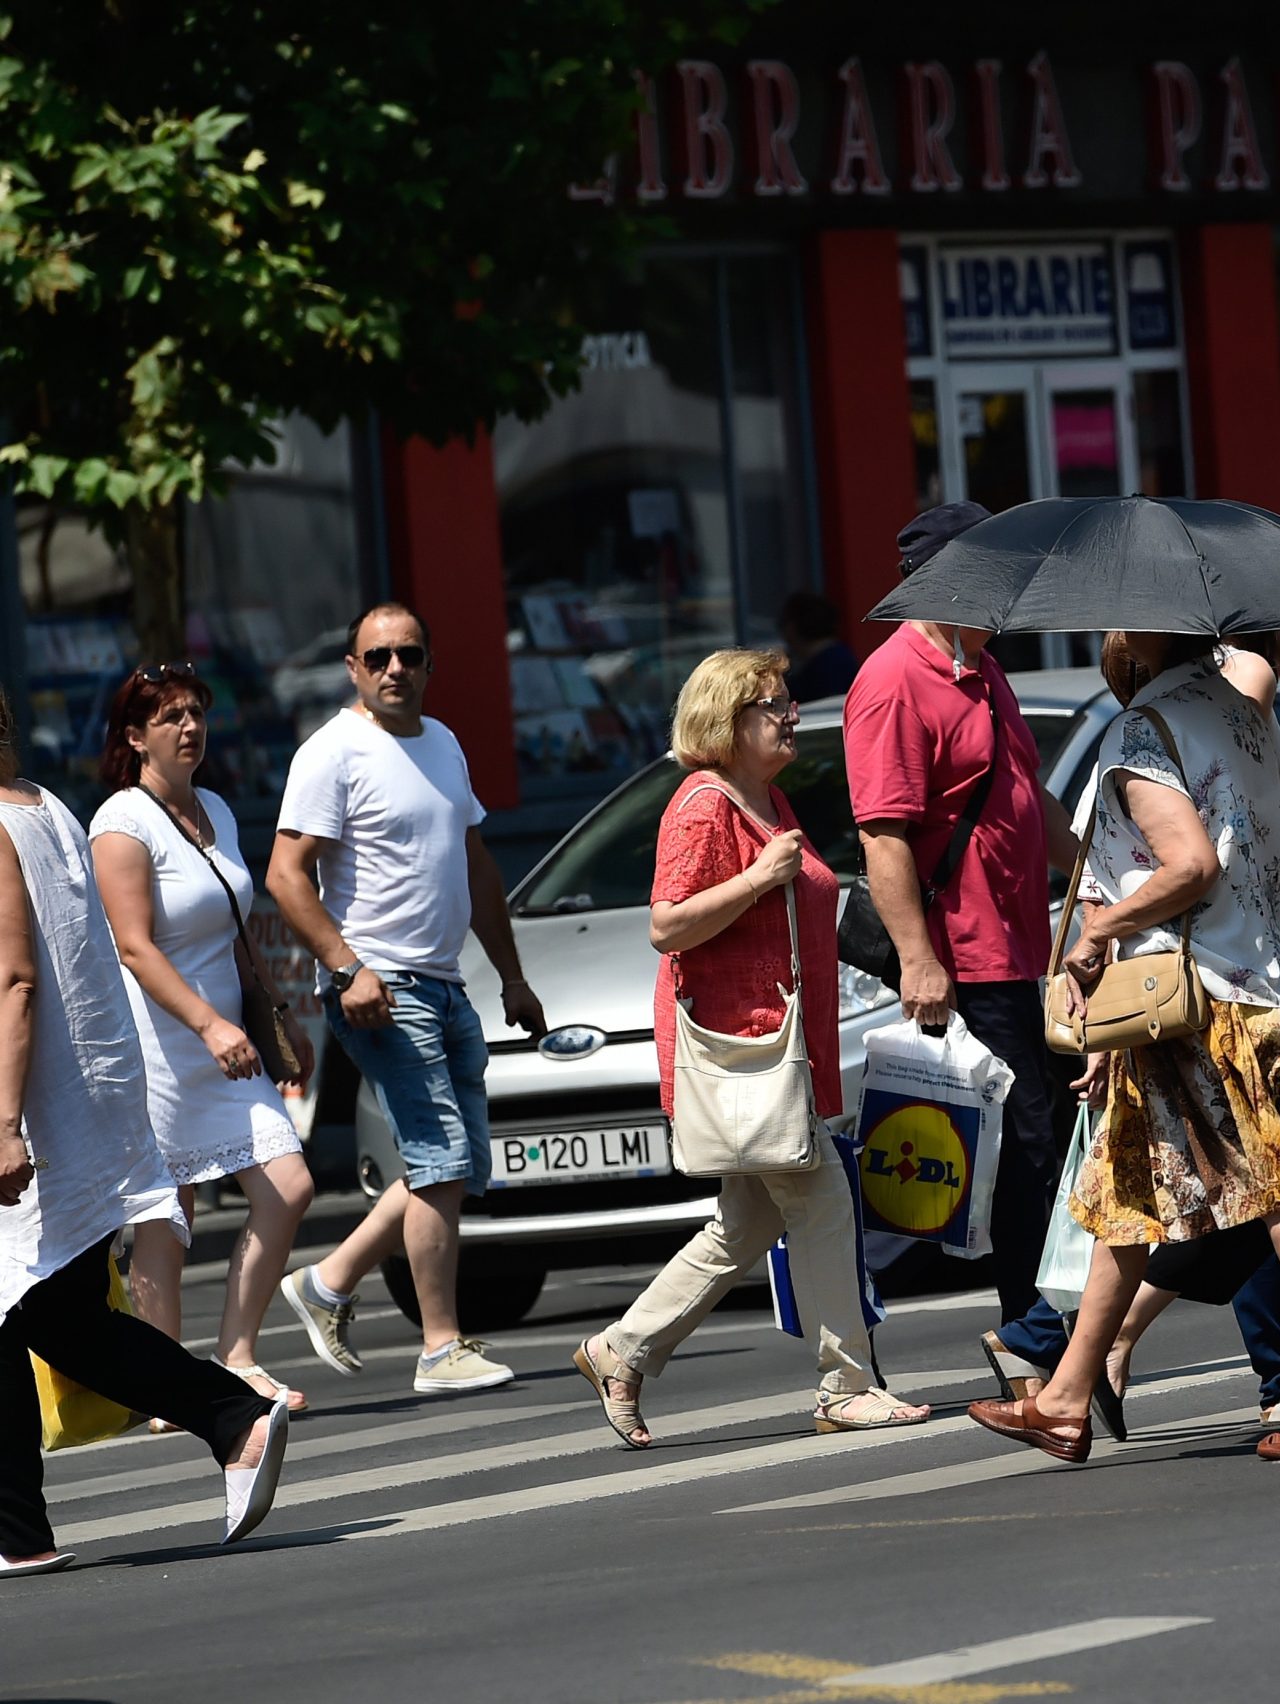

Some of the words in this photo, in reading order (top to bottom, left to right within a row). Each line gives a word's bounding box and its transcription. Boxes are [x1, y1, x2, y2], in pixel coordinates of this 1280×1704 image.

[940, 255, 1109, 319] LIBRARIE
[503, 1139, 527, 1173] B
[537, 1135, 588, 1171] 120
[600, 1130, 651, 1167] LMI
